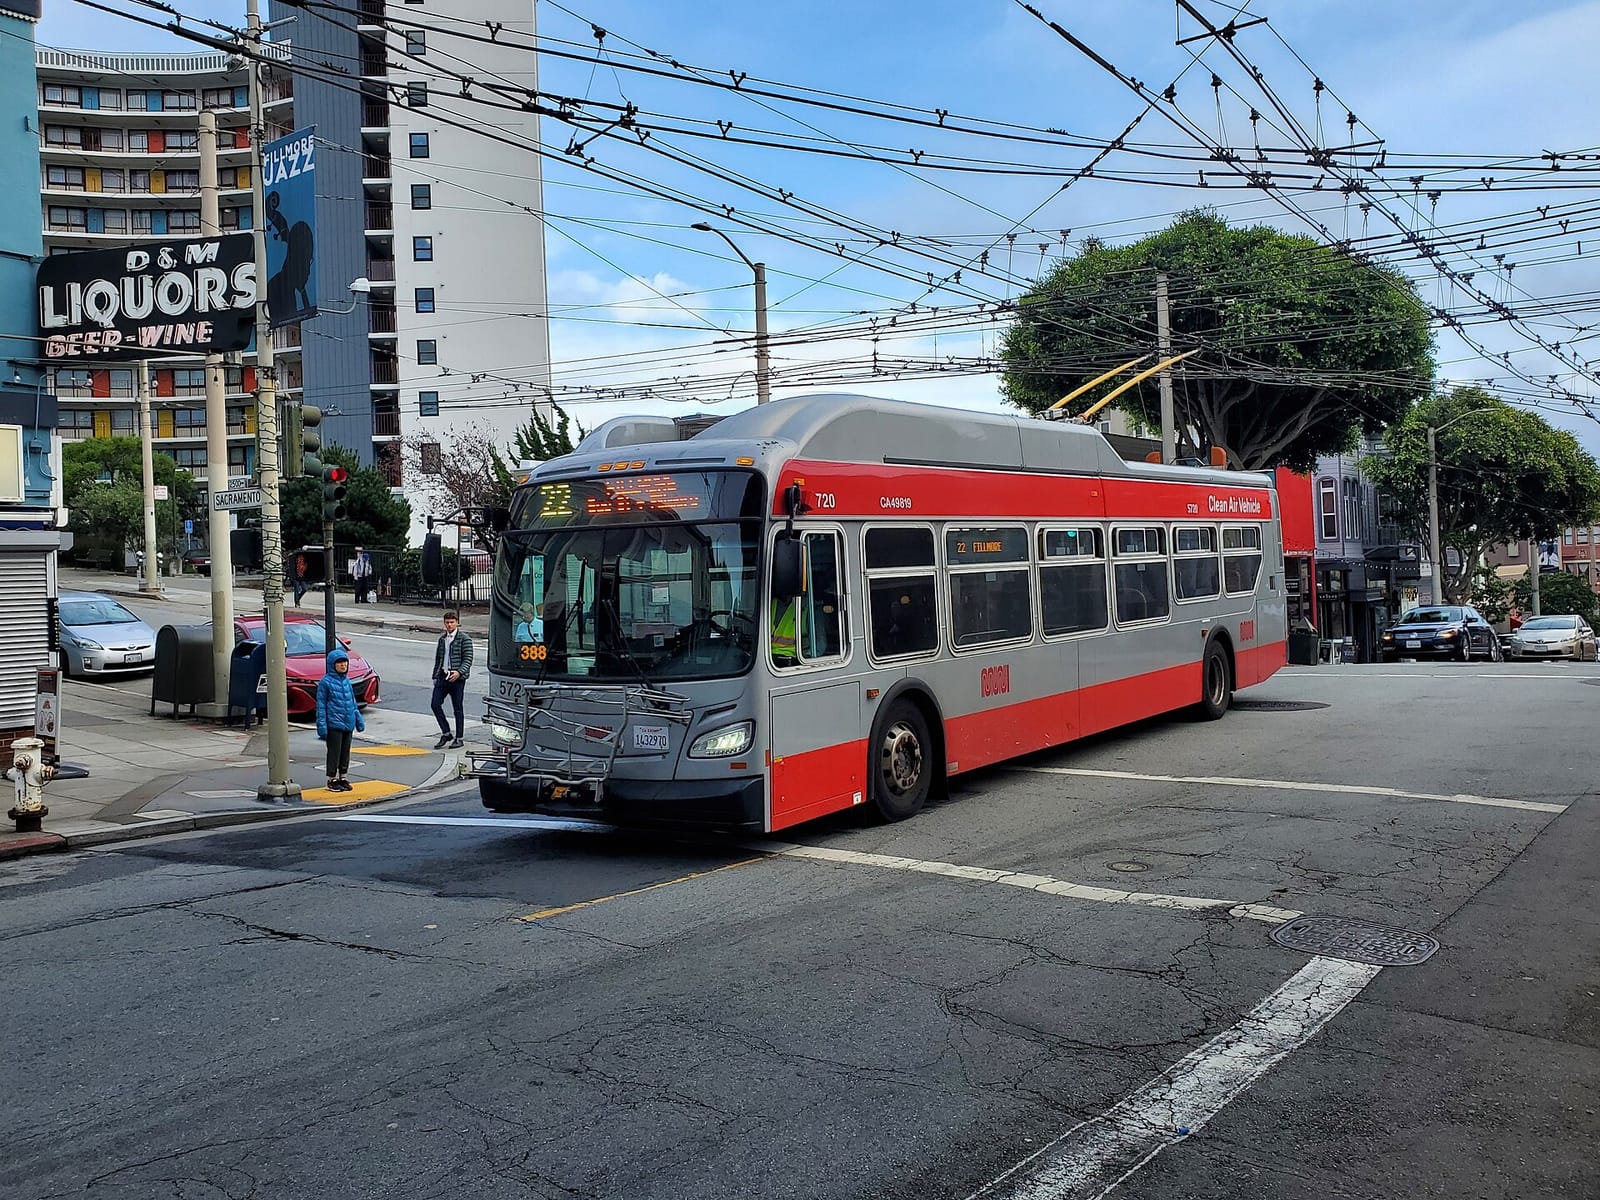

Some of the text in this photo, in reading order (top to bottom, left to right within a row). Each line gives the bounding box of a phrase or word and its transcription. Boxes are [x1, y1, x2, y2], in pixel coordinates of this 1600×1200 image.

[264, 134, 314, 167] FILLMORE
[263, 145, 315, 186] JAZZ
[126, 242, 220, 272] D & M
[39, 262, 257, 329] LIQUORS
[215, 491, 261, 506] SACRAMENTO
[815, 493, 836, 508] 720
[880, 496, 912, 509] CA49819
[1208, 495, 1260, 514] Clean Air Vehicle
[957, 541, 1003, 553] 22 FILLMORE
[520, 645, 547, 660] 388
[636, 734, 667, 747] 1432970
